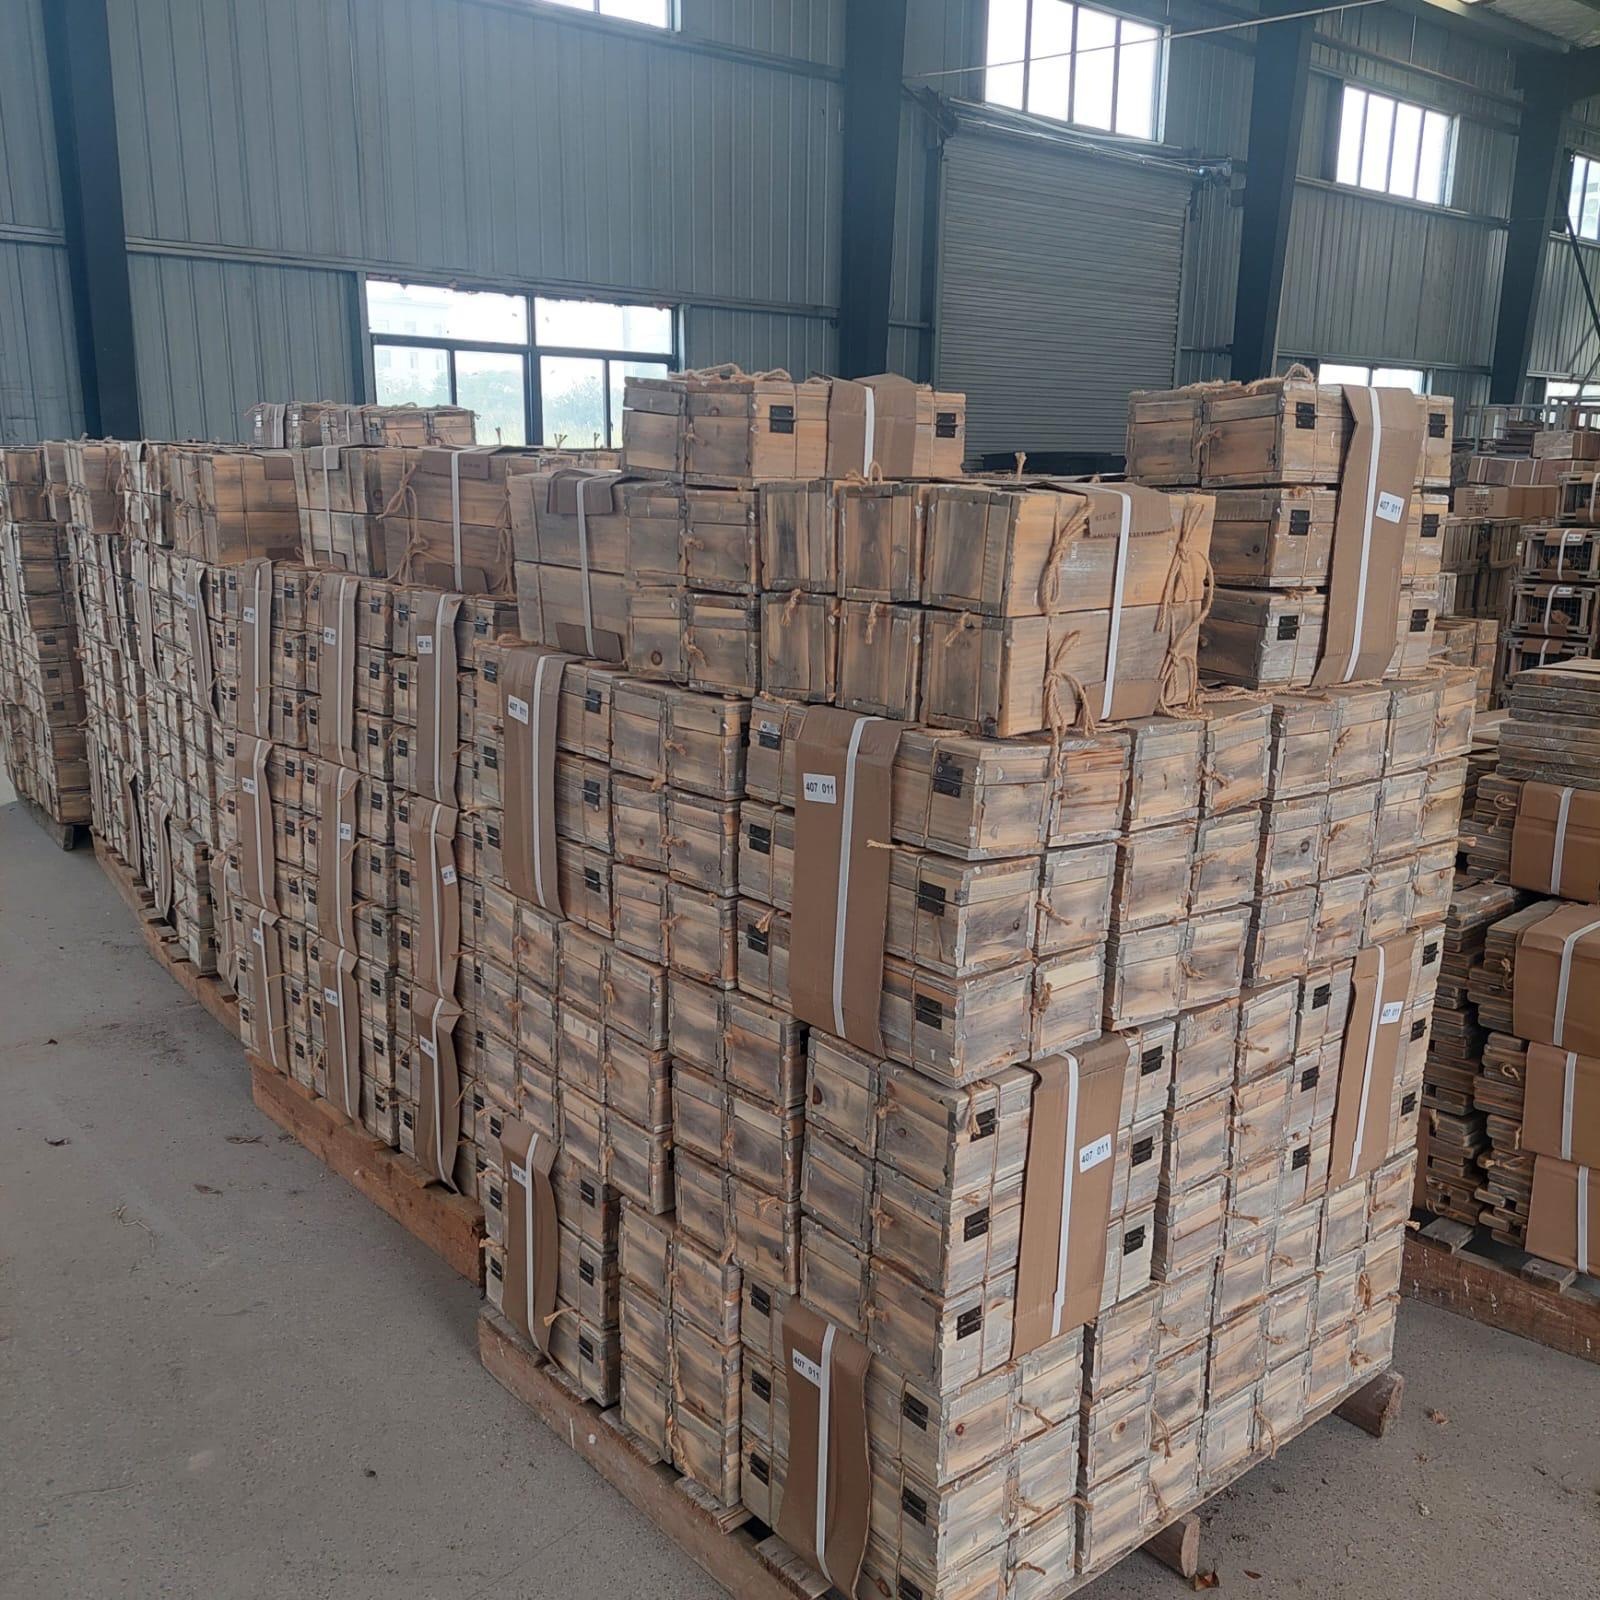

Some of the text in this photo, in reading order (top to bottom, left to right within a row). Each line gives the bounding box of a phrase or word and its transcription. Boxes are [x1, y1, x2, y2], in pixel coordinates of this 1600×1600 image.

[806, 781, 834, 794] 407 011
[1082, 1142, 1109, 1164] 407 011
[794, 1356, 819, 1378] 407 011
